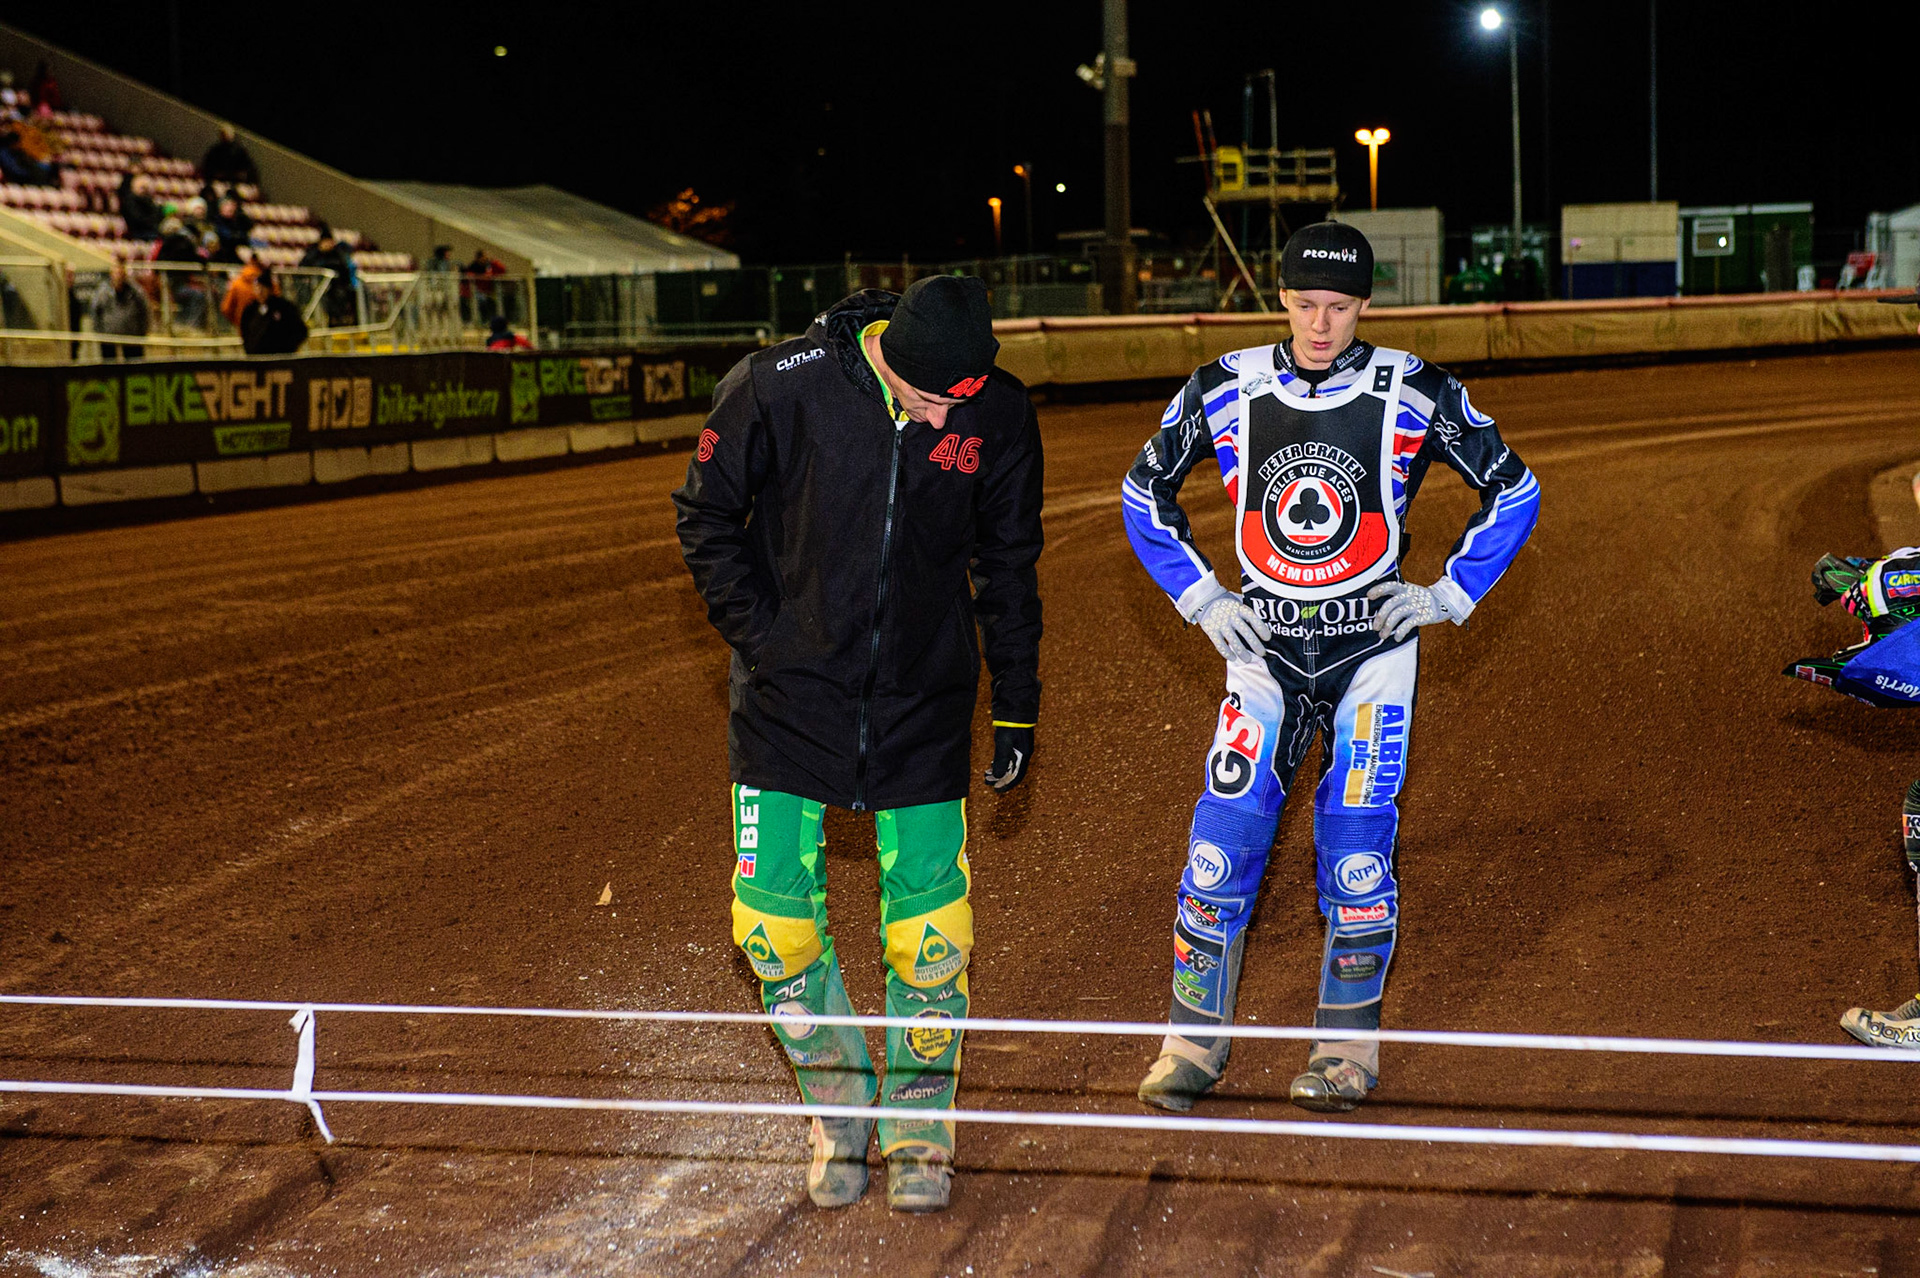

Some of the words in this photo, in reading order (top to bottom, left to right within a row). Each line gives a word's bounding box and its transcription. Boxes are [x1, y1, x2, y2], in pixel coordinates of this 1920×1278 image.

[126, 370, 293, 427] BIKERIGHT
[946, 375, 988, 398] 46
[929, 433, 984, 474] 46
[1258, 443, 1302, 482] PETER
[1303, 441, 1367, 482] CRAVEN
[1268, 470, 1297, 503] BELLE
[1300, 465, 1326, 478] VUE
[1329, 475, 1353, 503] ACES
[1285, 544, 1332, 556] MANCHESTER
[1266, 554, 1352, 582] MEMORIAL
[1372, 704, 1383, 748] ENGINEERING
[1351, 740, 1371, 770] plc
[1369, 703, 1405, 806] ALBON
[1193, 853, 1220, 878] ATPI
[1347, 862, 1378, 885] ATPI
